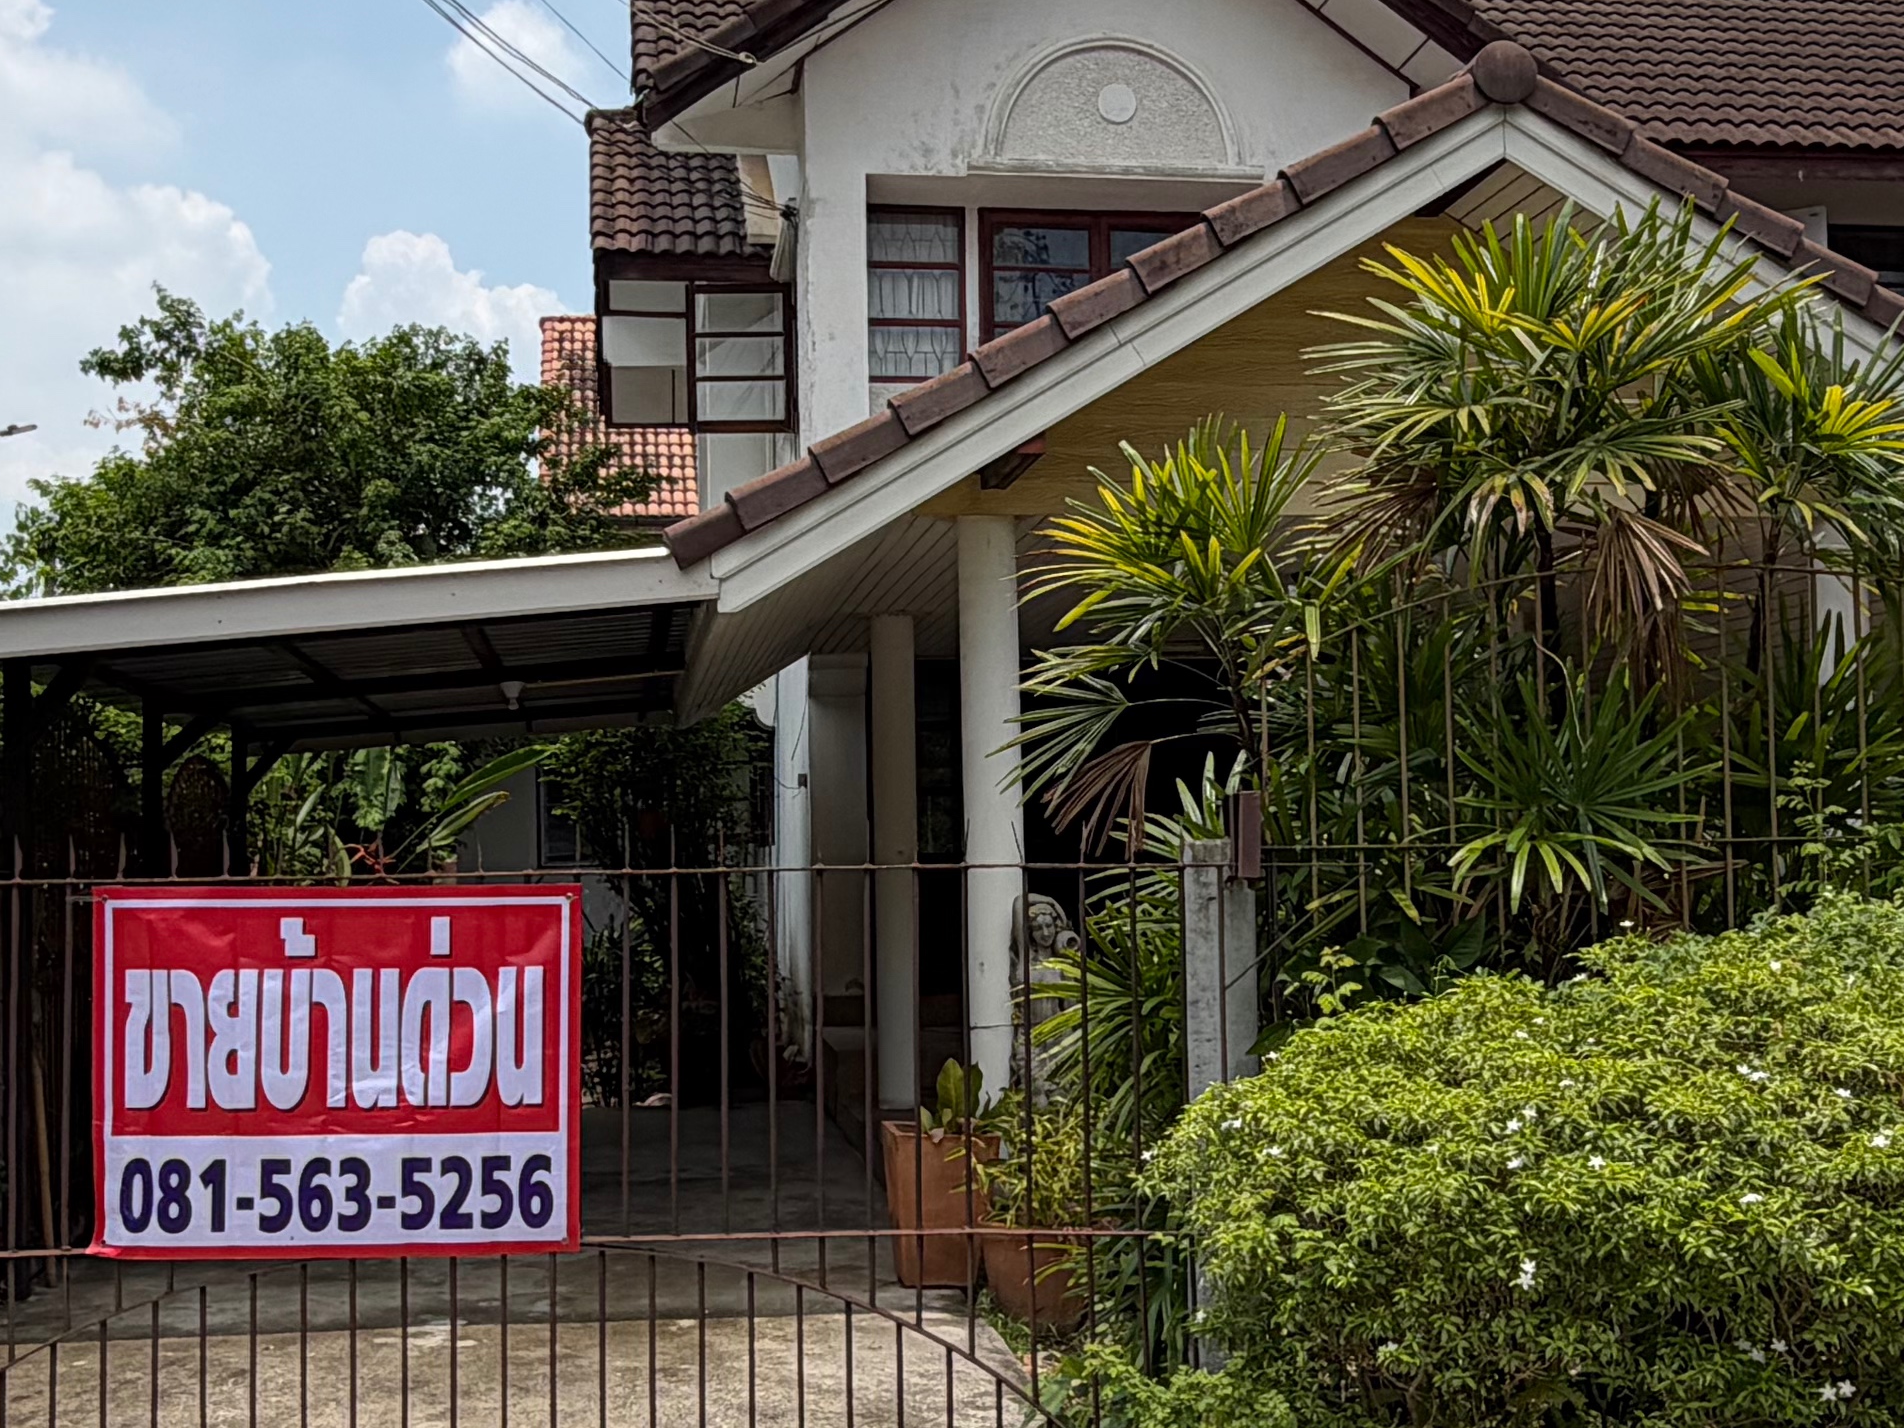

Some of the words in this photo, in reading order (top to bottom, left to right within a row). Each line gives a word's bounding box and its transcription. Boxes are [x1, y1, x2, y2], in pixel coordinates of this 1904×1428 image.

[124, 916, 544, 1110] ขายบ้านด่วน
[119, 1154, 553, 1234] 081-563-5256
